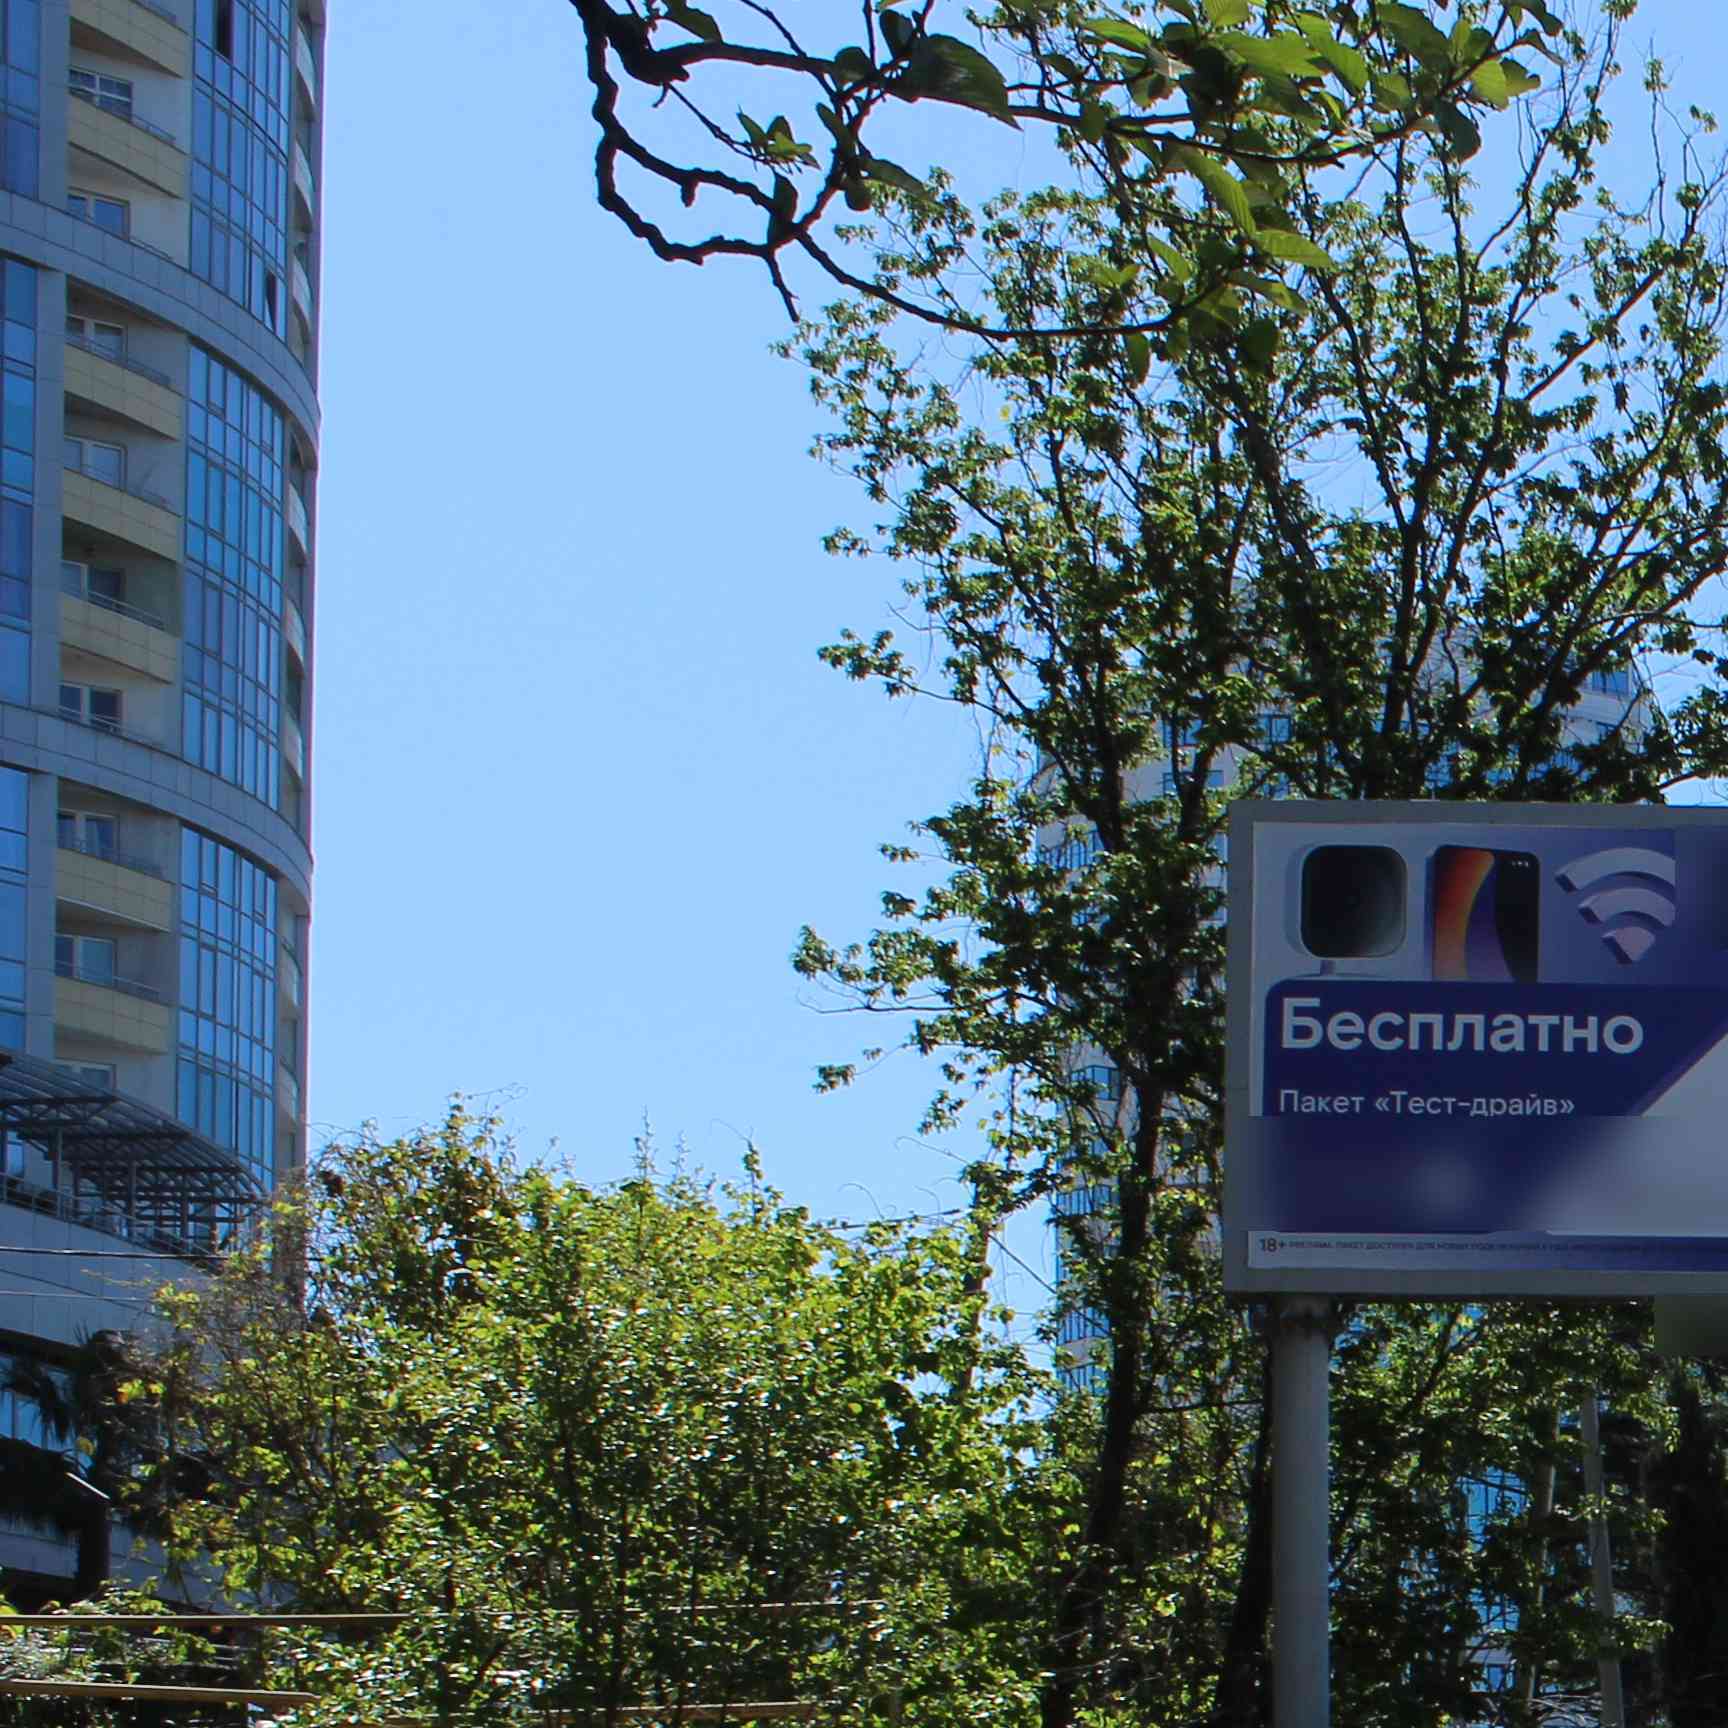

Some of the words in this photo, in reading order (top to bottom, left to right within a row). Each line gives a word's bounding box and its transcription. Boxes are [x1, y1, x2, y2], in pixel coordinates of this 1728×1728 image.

[1281, 997, 1645, 1055] Бесплатно
[1279, 1089, 1365, 1114] Пакет
[1374, 1090, 1576, 1117] «Тест-драйв»
[1259, 1237, 1286, 1253] 18+
